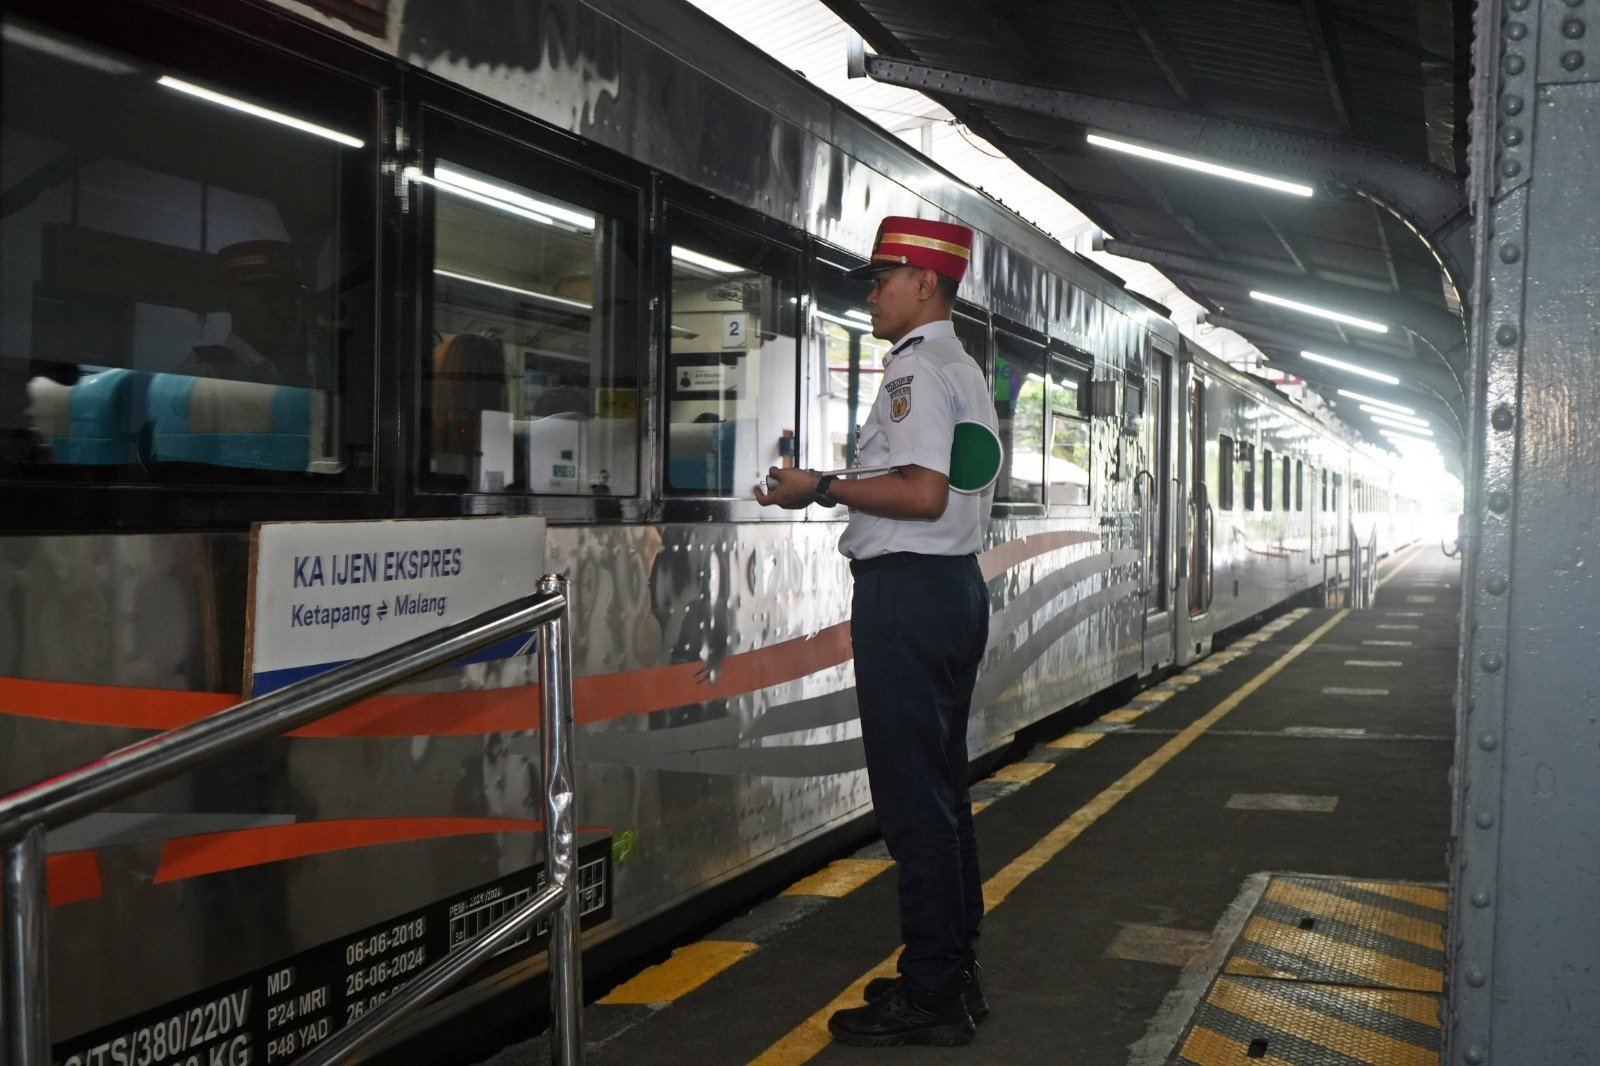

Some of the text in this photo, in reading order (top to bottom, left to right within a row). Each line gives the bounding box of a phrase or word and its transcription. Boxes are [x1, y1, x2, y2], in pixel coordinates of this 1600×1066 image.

[729, 321, 739, 337] 2
[293, 547, 462, 589] KA IJEN EKSPRES
[291, 592, 446, 630] Ketapang Malang
[346, 918, 424, 966] 06-06-2018
[267, 968, 292, 997] MD
[346, 947, 424, 997] 26-06-2024
[267, 987, 326, 1031] P24 MRI
[209, 1034, 250, 1066] KG
[267, 1018, 328, 1064] P48 YAD
